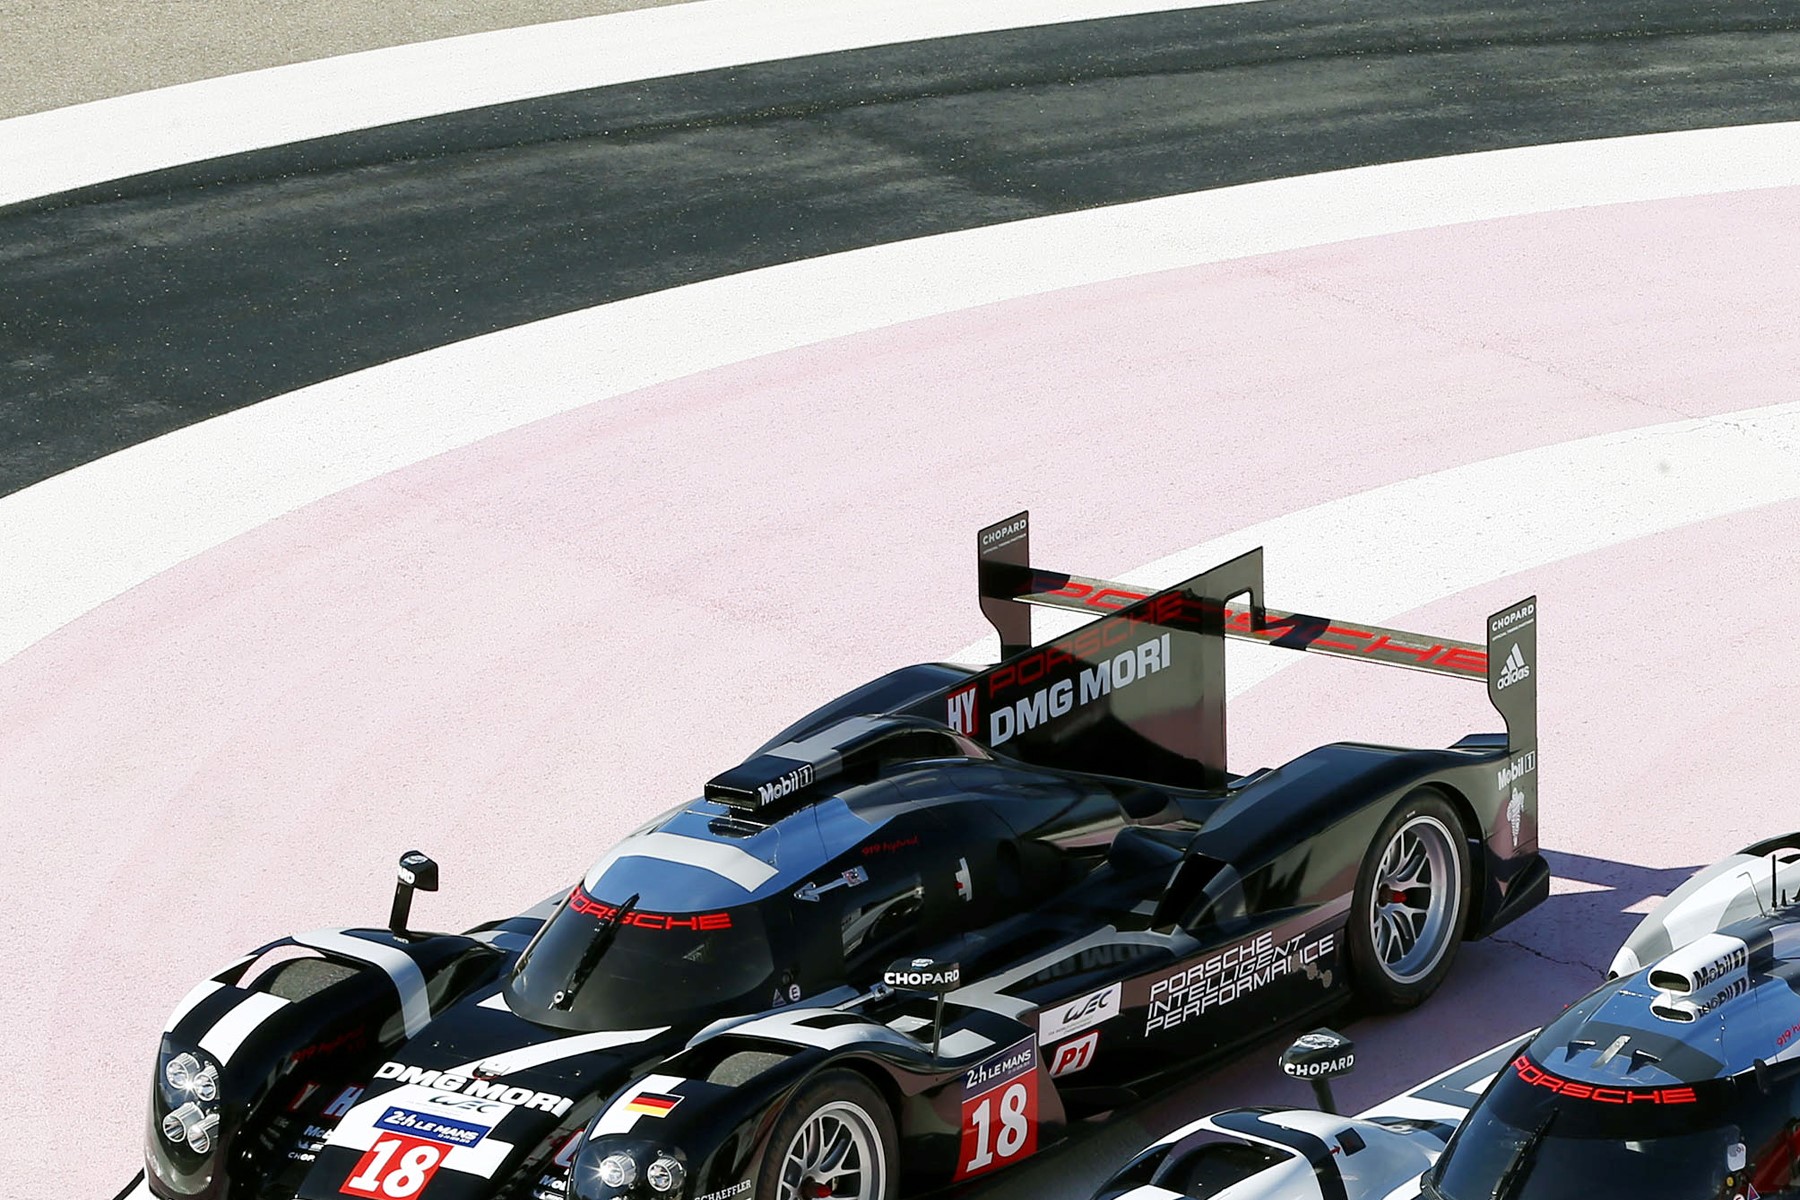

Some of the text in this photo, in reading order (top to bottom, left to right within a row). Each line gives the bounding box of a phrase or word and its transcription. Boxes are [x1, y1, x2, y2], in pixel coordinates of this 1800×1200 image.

[982, 518, 1027, 546] CHOPARD
[1491, 602, 1535, 632] CHOPARD
[990, 591, 1183, 699] PORSCHE
[990, 632, 1171, 748] DMG MORI
[1497, 663, 1530, 690] adidas
[757, 768, 800, 807] Mobil
[568, 884, 733, 931] PORSCHE
[883, 968, 961, 988] CHOPARD
[1147, 933, 1306, 1020] INTELLIGENT
[1150, 931, 1274, 1002] PORSCHE
[1693, 953, 1733, 990] Mobil
[988, 1063, 1002, 1079] LE
[1002, 1049, 1032, 1073] MANS
[1053, 1040, 1092, 1076] P1
[1283, 1054, 1355, 1076] CHOPARD
[373, 1061, 468, 1092] DMG
[463, 1081, 575, 1118] MORI
[1510, 1055, 1698, 1104] PORSCHE
[413, 1121, 436, 1132] LE
[435, 1124, 480, 1141] MANS
[965, 1083, 1028, 1173] 18
[348, 1139, 440, 1198] 18
